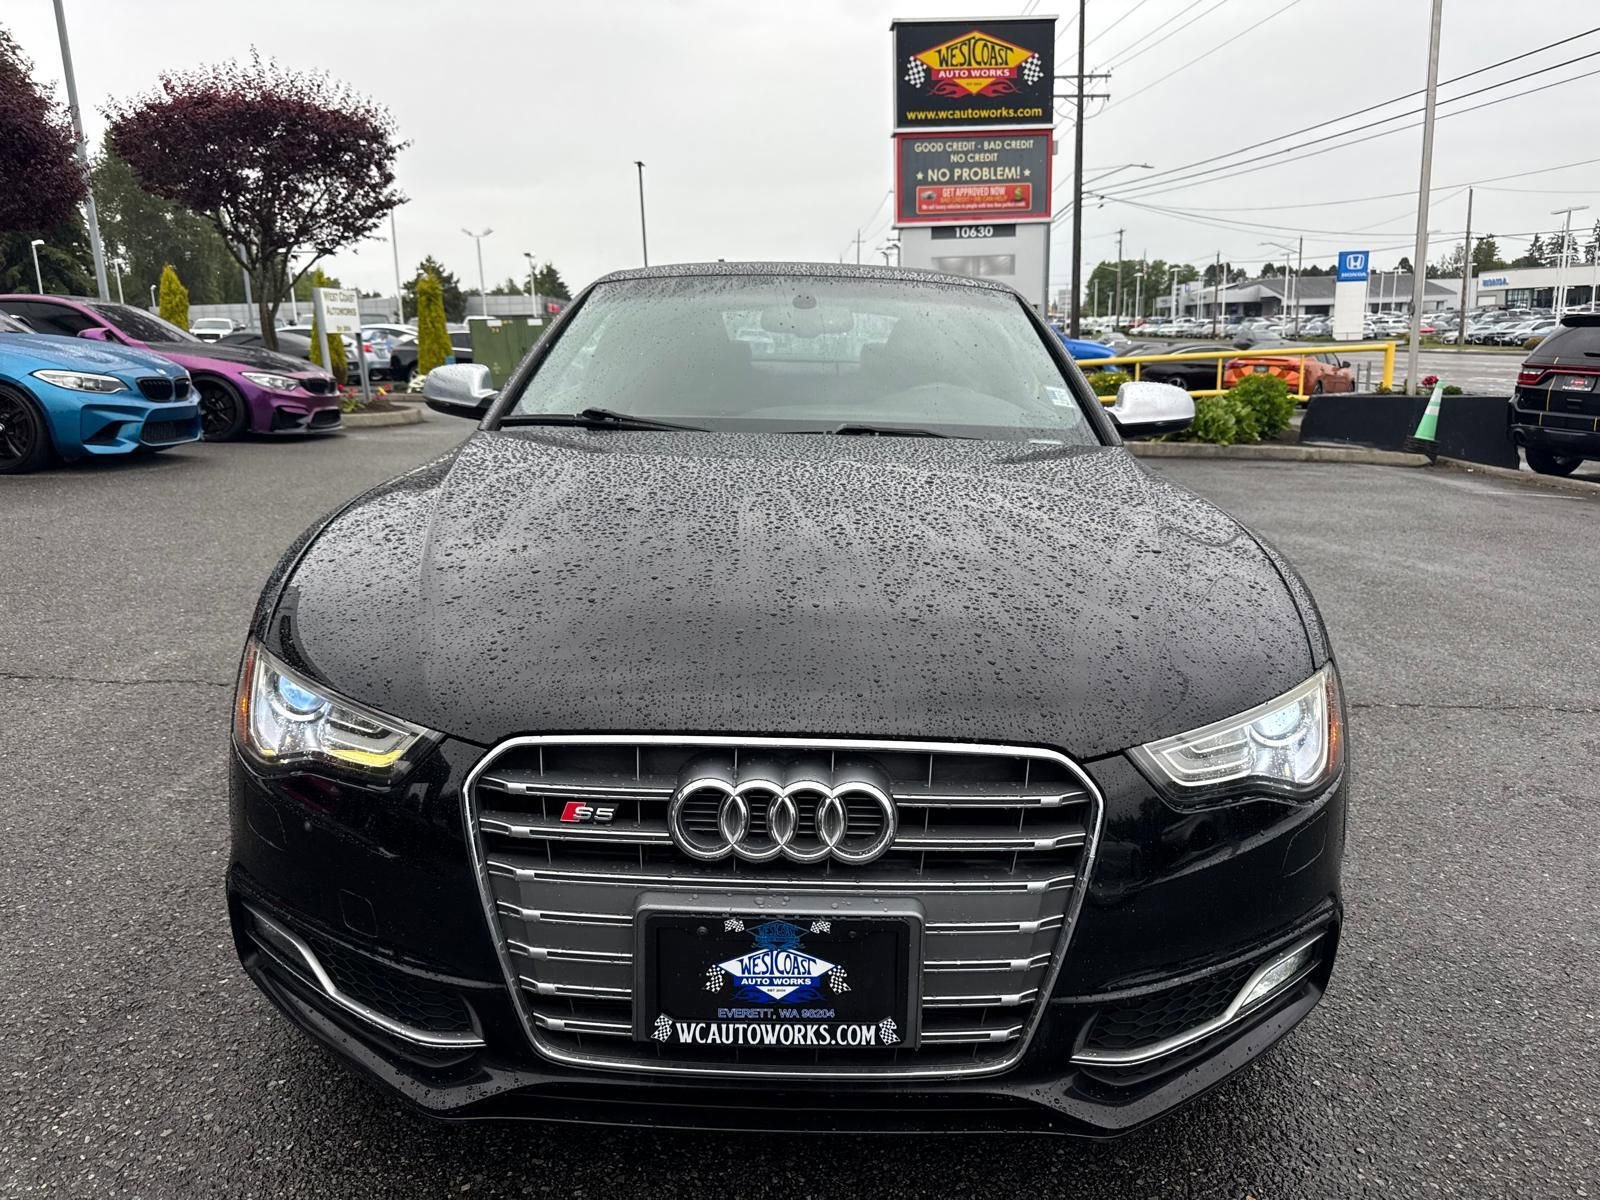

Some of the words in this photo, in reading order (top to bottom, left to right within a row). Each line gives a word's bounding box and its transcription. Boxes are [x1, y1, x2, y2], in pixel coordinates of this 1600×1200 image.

[938, 70, 969, 78] AUTO
[970, 69, 1010, 78] WORKS
[906, 107, 1042, 120] www.wcautoworks.com
[914, 142, 944, 153] GOOD
[945, 141, 976, 152] CREDIT
[983, 140, 1002, 150] BAD
[1004, 140, 1034, 149] CREDIT
[950, 154, 965, 163] NO
[967, 153, 998, 162] CREDIT
[927, 168, 950, 182] NO
[954, 166, 1020, 182] PROBLEM!
[942, 188, 955, 197] GET
[955, 187, 989, 197] APPROVED
[990, 186, 1006, 195] NOW
[955, 227, 993, 238] 10630
[573, 806, 615, 820] S5
[718, 1008, 776, 1019] EVERETT,
[779, 1008, 800, 1018] WA
[801, 1008, 835, 1018] 98204
[675, 1022, 876, 1046] WCAUTOWORKS.COM
